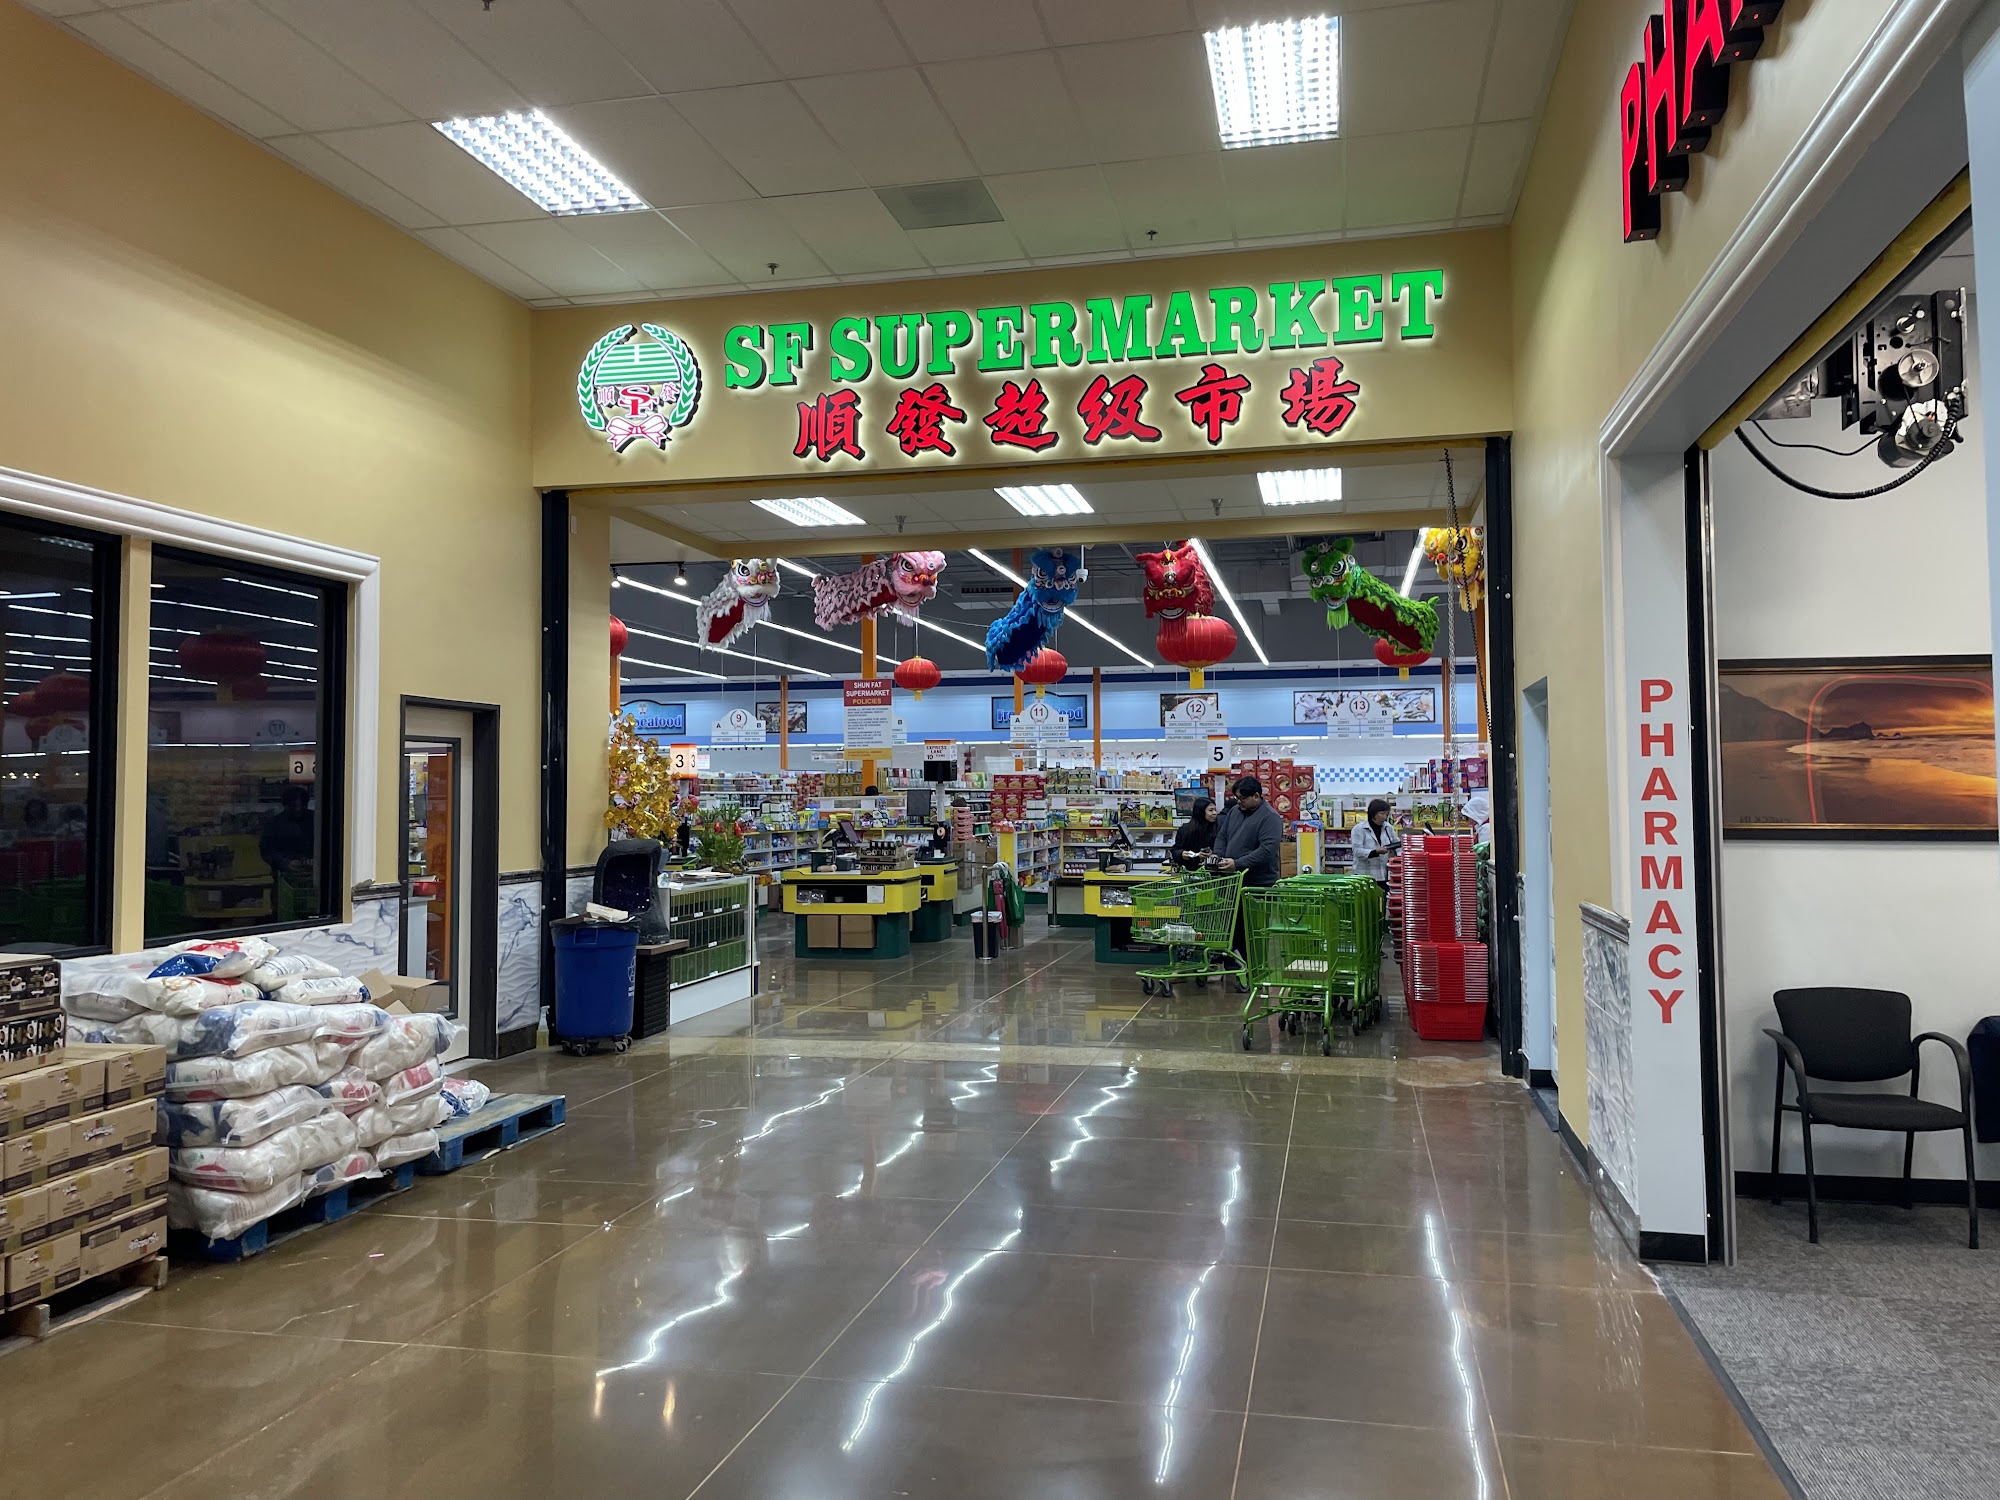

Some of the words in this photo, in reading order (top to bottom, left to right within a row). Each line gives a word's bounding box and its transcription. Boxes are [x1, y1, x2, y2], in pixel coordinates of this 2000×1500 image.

[1621, 0, 1745, 242] PHA
[723, 321, 813, 390] SF
[829, 269, 1444, 383] SUPERMARKET
[1034, 708, 1043, 716] 11
[1190, 704, 1202, 713] 12
[1353, 701, 1366, 710] 13
[736, 714, 742, 722] 9
[675, 754, 684, 768] 3
[691, 754, 696, 768] 3
[1213, 746, 1224, 762] 5
[1640, 678, 1685, 1024] PHARMACY
